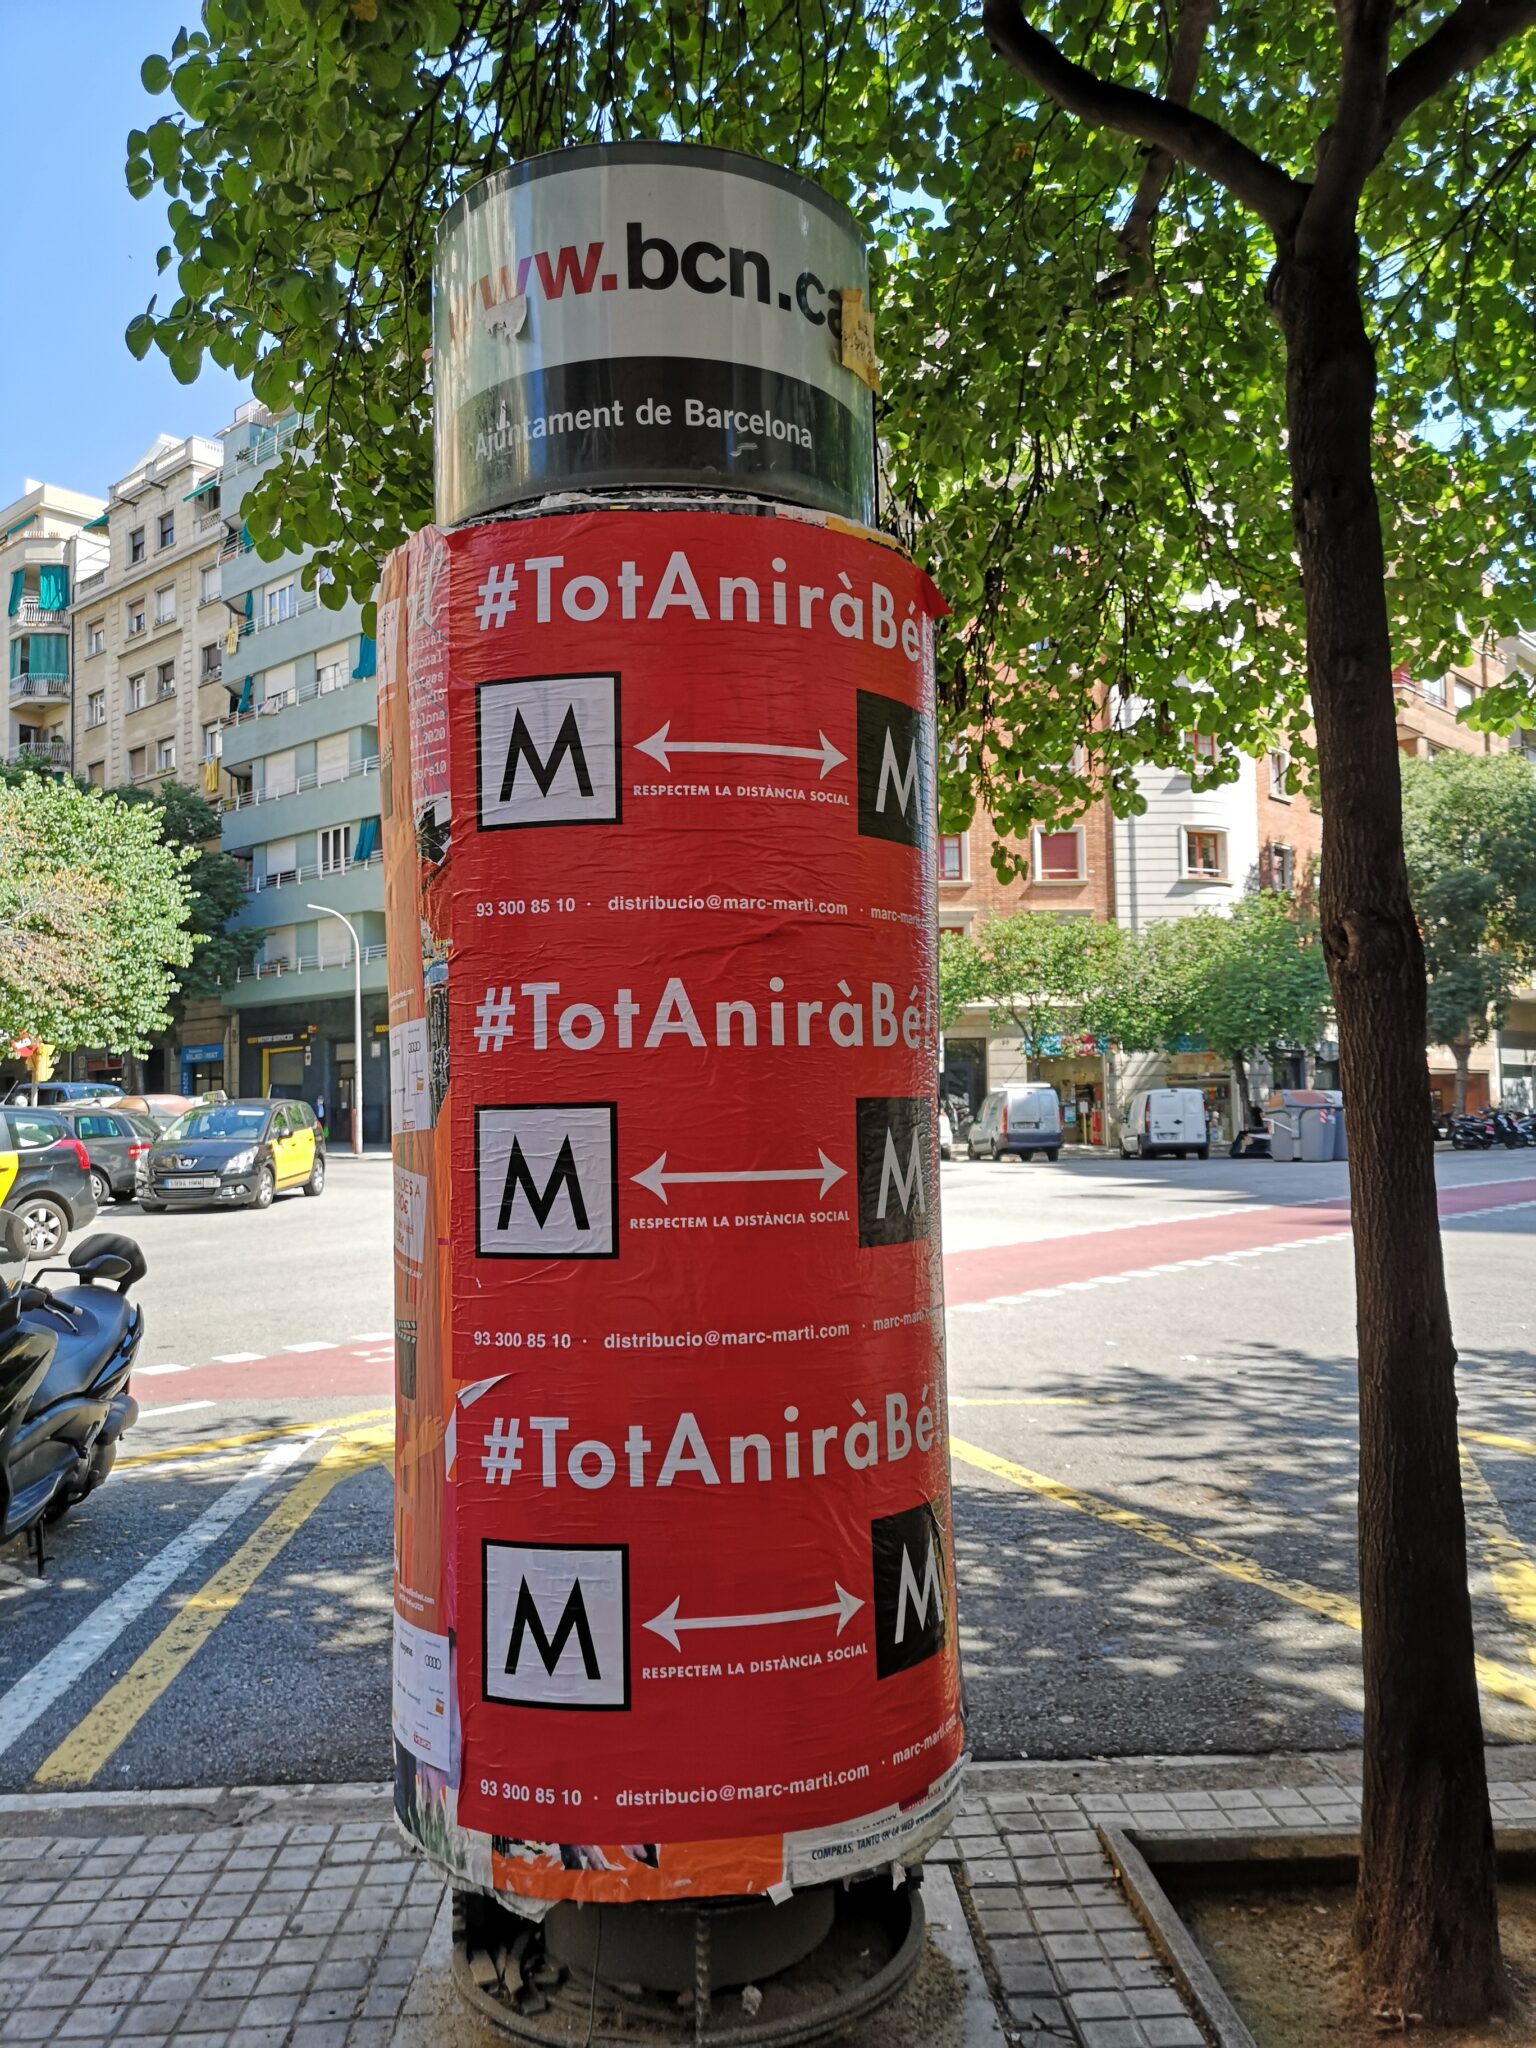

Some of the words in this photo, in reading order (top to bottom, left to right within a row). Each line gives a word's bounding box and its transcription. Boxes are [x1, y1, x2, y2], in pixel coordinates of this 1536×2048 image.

[475, 400, 624, 462] Ajuntament
[636, 398, 671, 425] de
[685, 400, 813, 450] Barcelona
[500, 703, 594, 801] M
[876, 726, 922, 824] M
[633, 785, 710, 797] RESPECTEM
[715, 785, 731, 797] LA
[736, 783, 806, 800] DISTÀNCIA
[809, 791, 850, 806] SOCIAL
[476, 903, 493, 918] 93
[498, 900, 525, 916] 300
[530, 898, 551, 915] 85
[557, 897, 576, 913] 10
[608, 894, 848, 916] distribucio@marc-marti.com
[497, 1134, 590, 1230] M
[876, 1126, 926, 1219] M
[630, 1215, 708, 1230] RESPECTEM
[713, 1215, 730, 1228] LA
[735, 1210, 805, 1227] DISTÀNCIA
[809, 1210, 851, 1225] SOCIAL
[474, 1330, 491, 1346] 93
[495, 1331, 522, 1347] 300
[527, 1332, 546, 1348] 85
[552, 1333, 571, 1349] 10
[604, 1323, 850, 1350] distribucio@marc-marti.com
[895, 1530, 944, 1644] M
[504, 1574, 601, 1680] M
[642, 1664, 722, 1680] RESPECTEM
[727, 1662, 745, 1675] LA
[749, 1653, 822, 1673] DISTÀNCIA
[827, 1644, 868, 1663] SOCIAL
[481, 1780, 498, 1797] 93
[503, 1784, 530, 1802] 300
[535, 1787, 555, 1804] 85
[561, 1789, 582, 1806] 10
[616, 1762, 870, 1807] distribucio@marc-marti.com
[811, 1843, 854, 1861] COMPRAS,
[857, 1834, 880, 1850] TANTO
